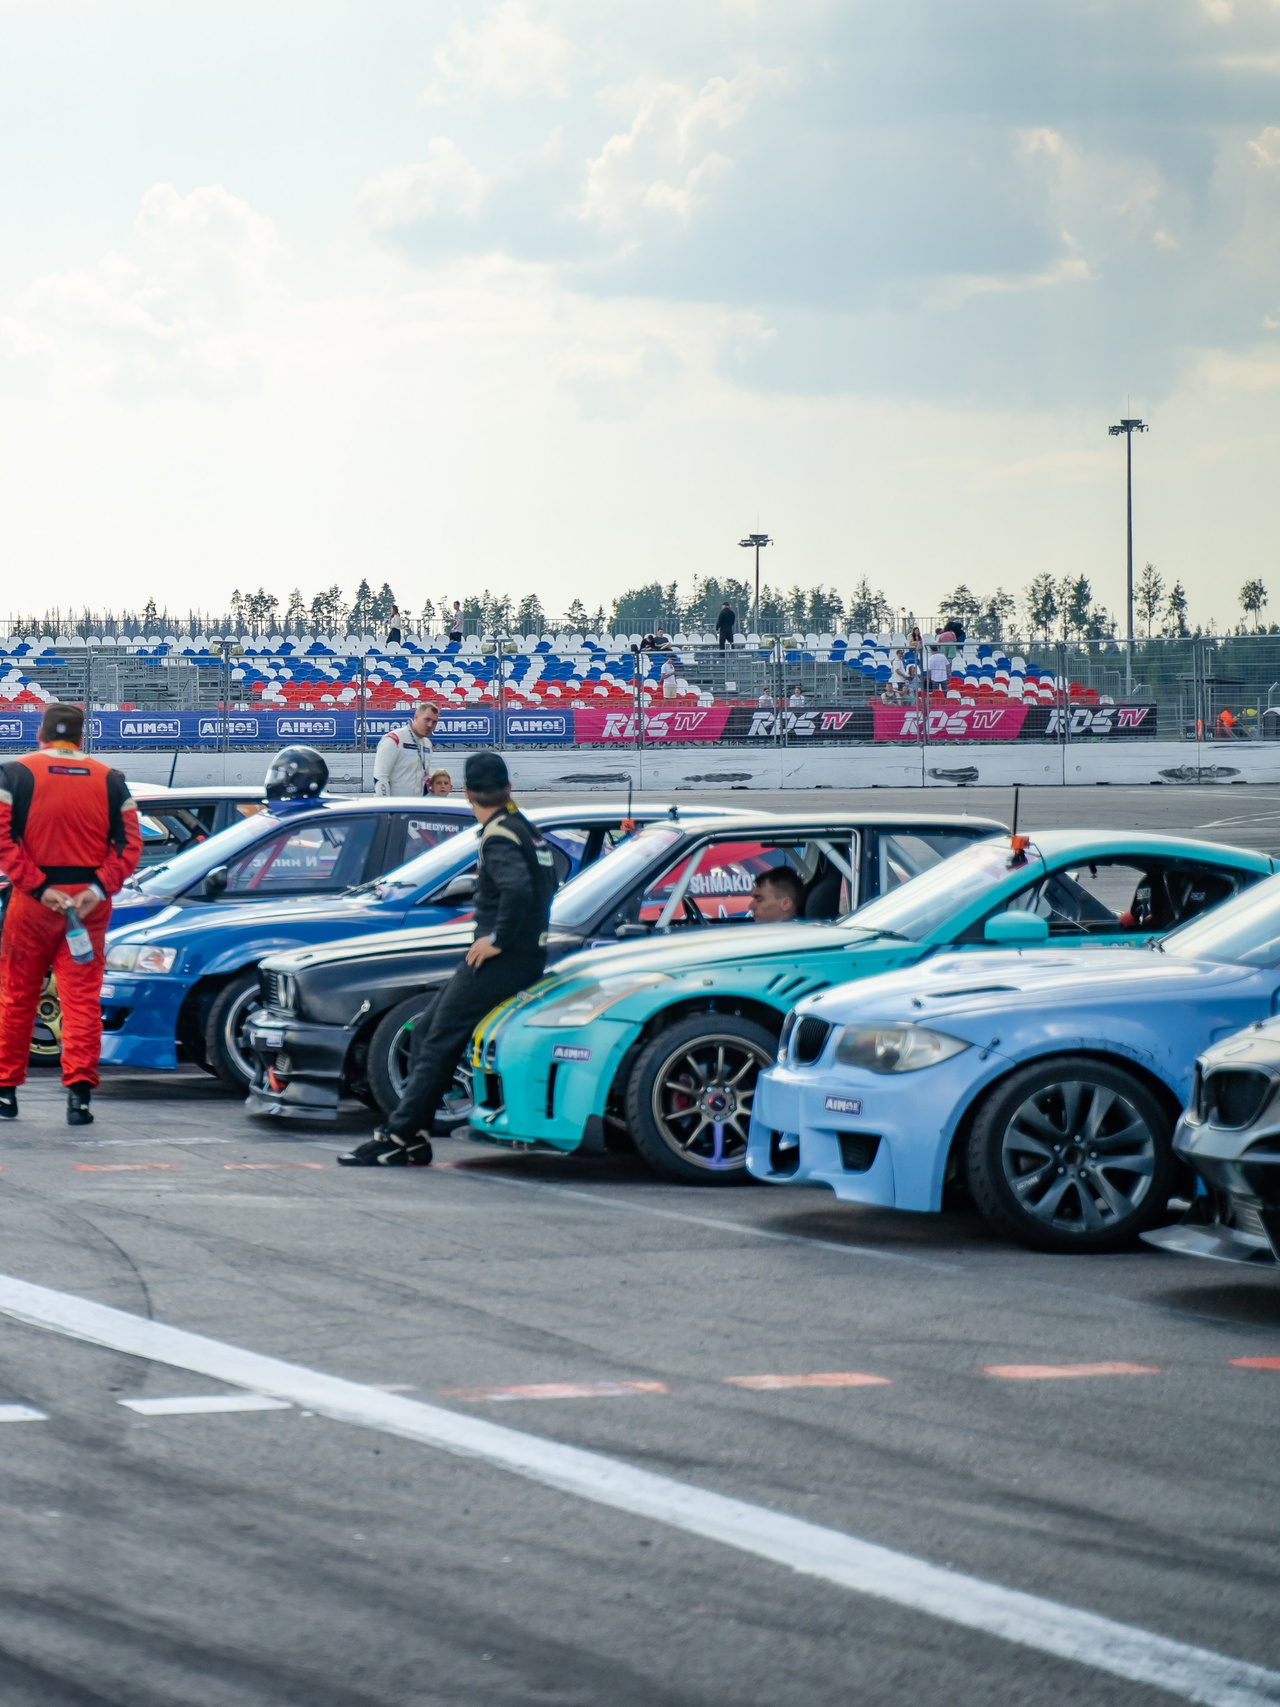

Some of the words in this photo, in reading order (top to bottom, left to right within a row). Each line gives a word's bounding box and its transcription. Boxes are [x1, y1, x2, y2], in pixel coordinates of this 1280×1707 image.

[123, 722, 178, 734] AIMOL
[279, 721, 333, 733] AIMOL
[434, 720, 487, 732] AIMOL
[510, 720, 562, 732] AIMOL
[602, 712, 674, 737] RDS
[674, 712, 707, 730] TV
[748, 712, 819, 736] RDS
[820, 712, 853, 730] TV
[900, 710, 971, 735] RDS
[972, 710, 1005, 728] TV
[1045, 709, 1117, 733] RDS
[1118, 708, 1150, 727] TV
[690, 874, 756, 893] SHMAKO
[825, 1098, 859, 1111] AIMOL
